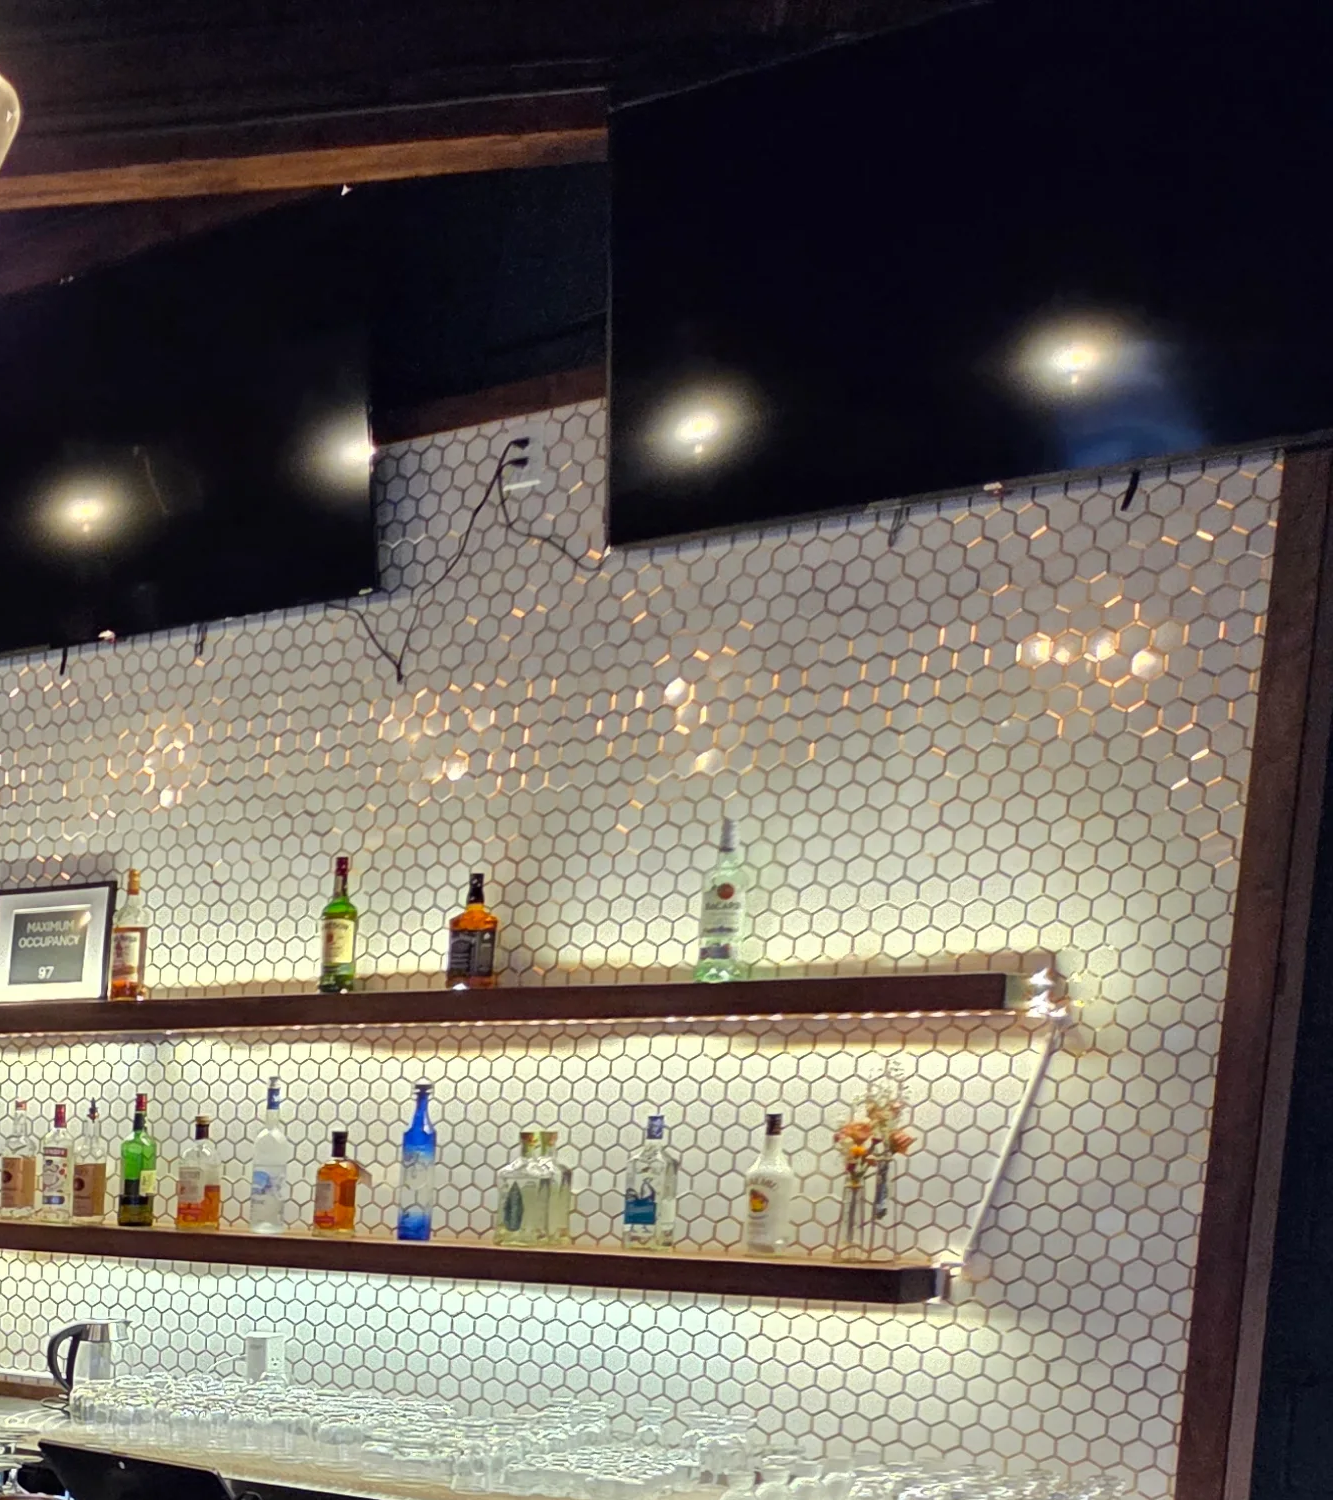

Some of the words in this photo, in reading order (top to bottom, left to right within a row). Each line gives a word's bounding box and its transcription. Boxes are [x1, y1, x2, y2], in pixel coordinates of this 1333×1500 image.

[27, 920, 75, 933] MAXIMUM
[18, 934, 81, 949] OCCUPANCY
[37, 966, 55, 979] 97
